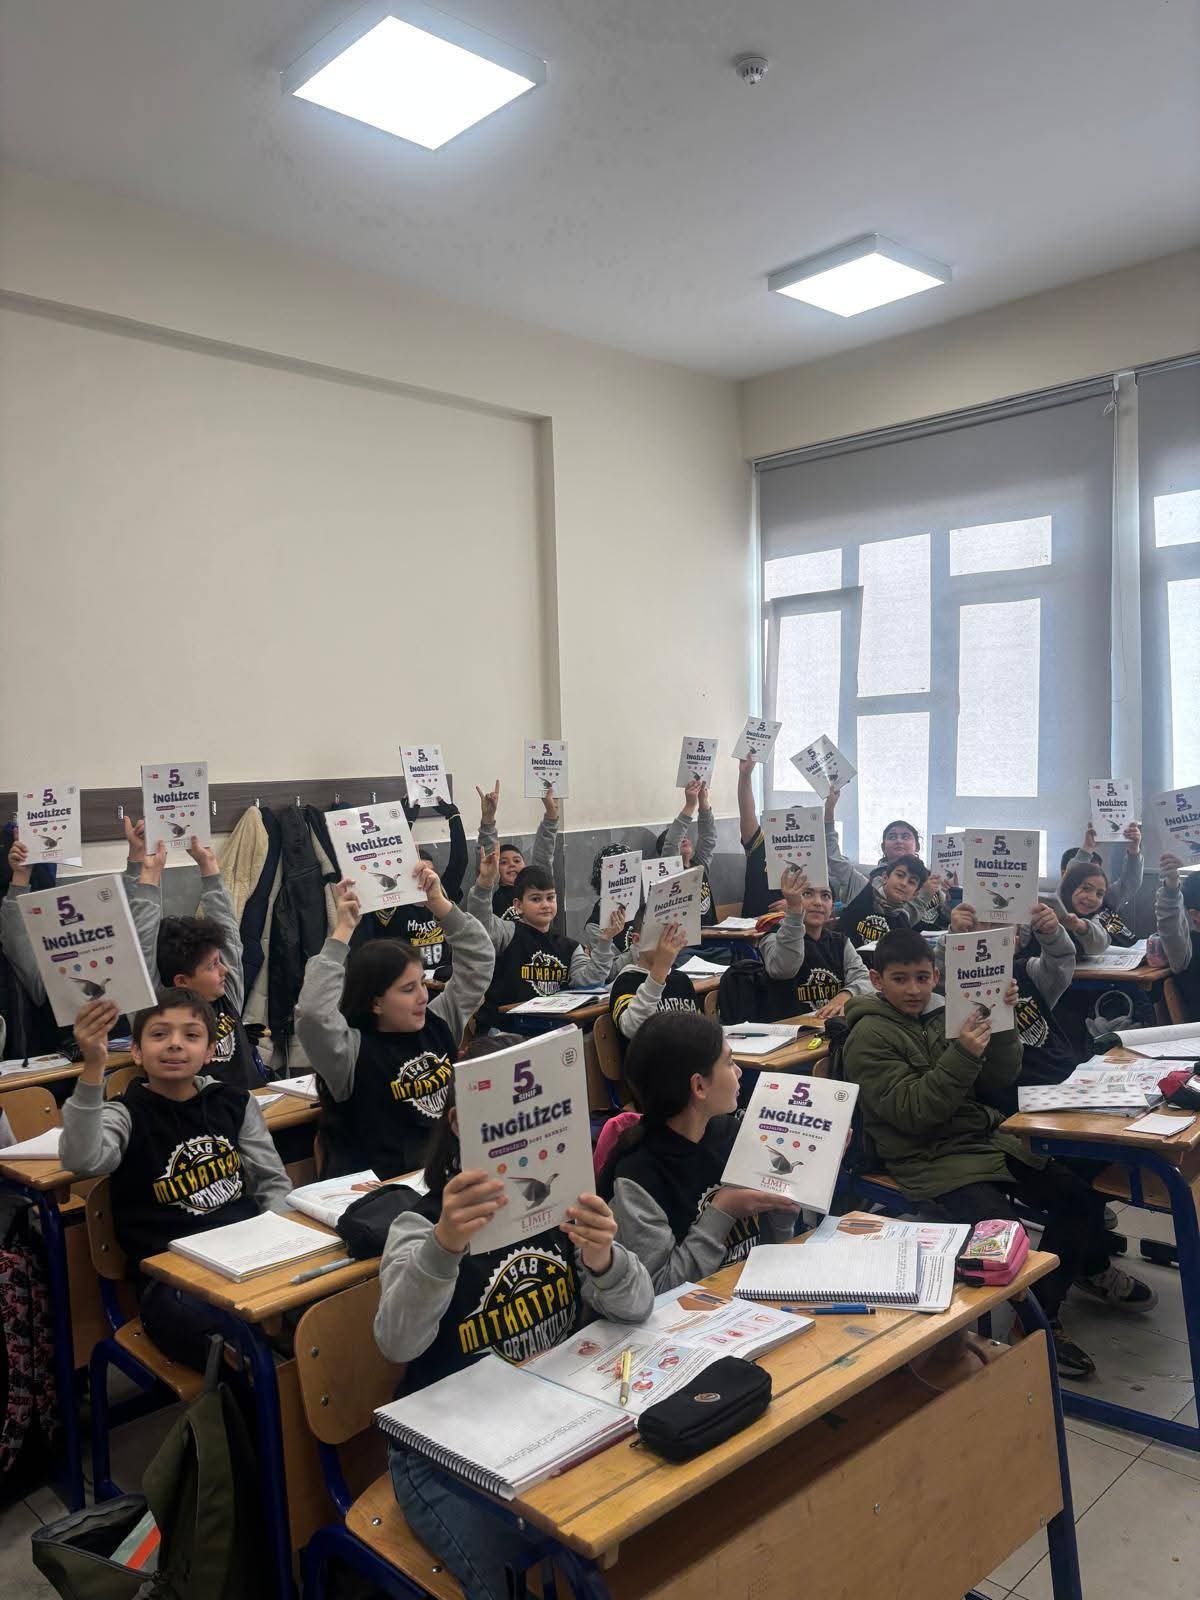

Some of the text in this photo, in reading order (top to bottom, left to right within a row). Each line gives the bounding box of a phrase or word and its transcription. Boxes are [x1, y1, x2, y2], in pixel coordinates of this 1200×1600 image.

[152, 791, 200, 804] İNGİLİZCE
[27, 807, 71, 820] İNGİLİZCE
[346, 835, 403, 853] İNGİLİZCE
[771, 833, 816, 844] İNGİLİZCE
[974, 858, 1027, 871] İNGİLİZCE
[608, 875, 637, 889] İNGİLİZCE
[42, 925, 115, 951] İNGİLİZCE
[957, 965, 1005, 980] İNGİLİZCE
[406, 1059, 429, 1081] 1948
[518, 1089, 537, 1101] SINIF
[480, 1098, 573, 1144] İNGİLİZCE
[758, 1106, 833, 1132] İNGİLİZCE
[503, 1258, 538, 1289] 1948
